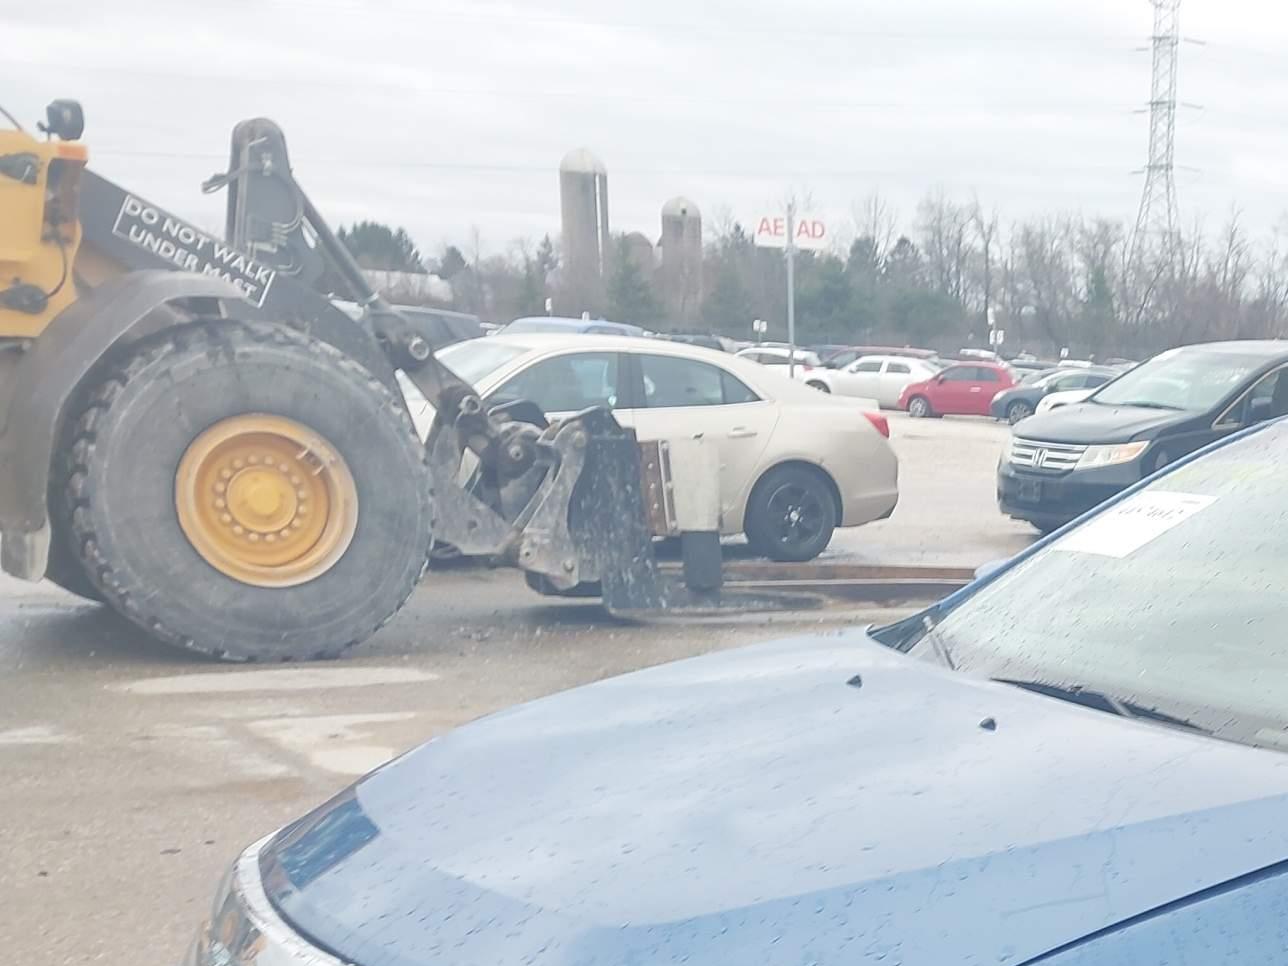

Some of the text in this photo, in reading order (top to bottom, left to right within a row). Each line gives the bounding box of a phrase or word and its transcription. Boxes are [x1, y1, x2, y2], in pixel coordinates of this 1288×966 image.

[125, 199, 270, 286] DO NOT WALK
[758, 217, 785, 237] AE
[797, 219, 825, 239] AD
[128, 224, 199, 272] UNDER
